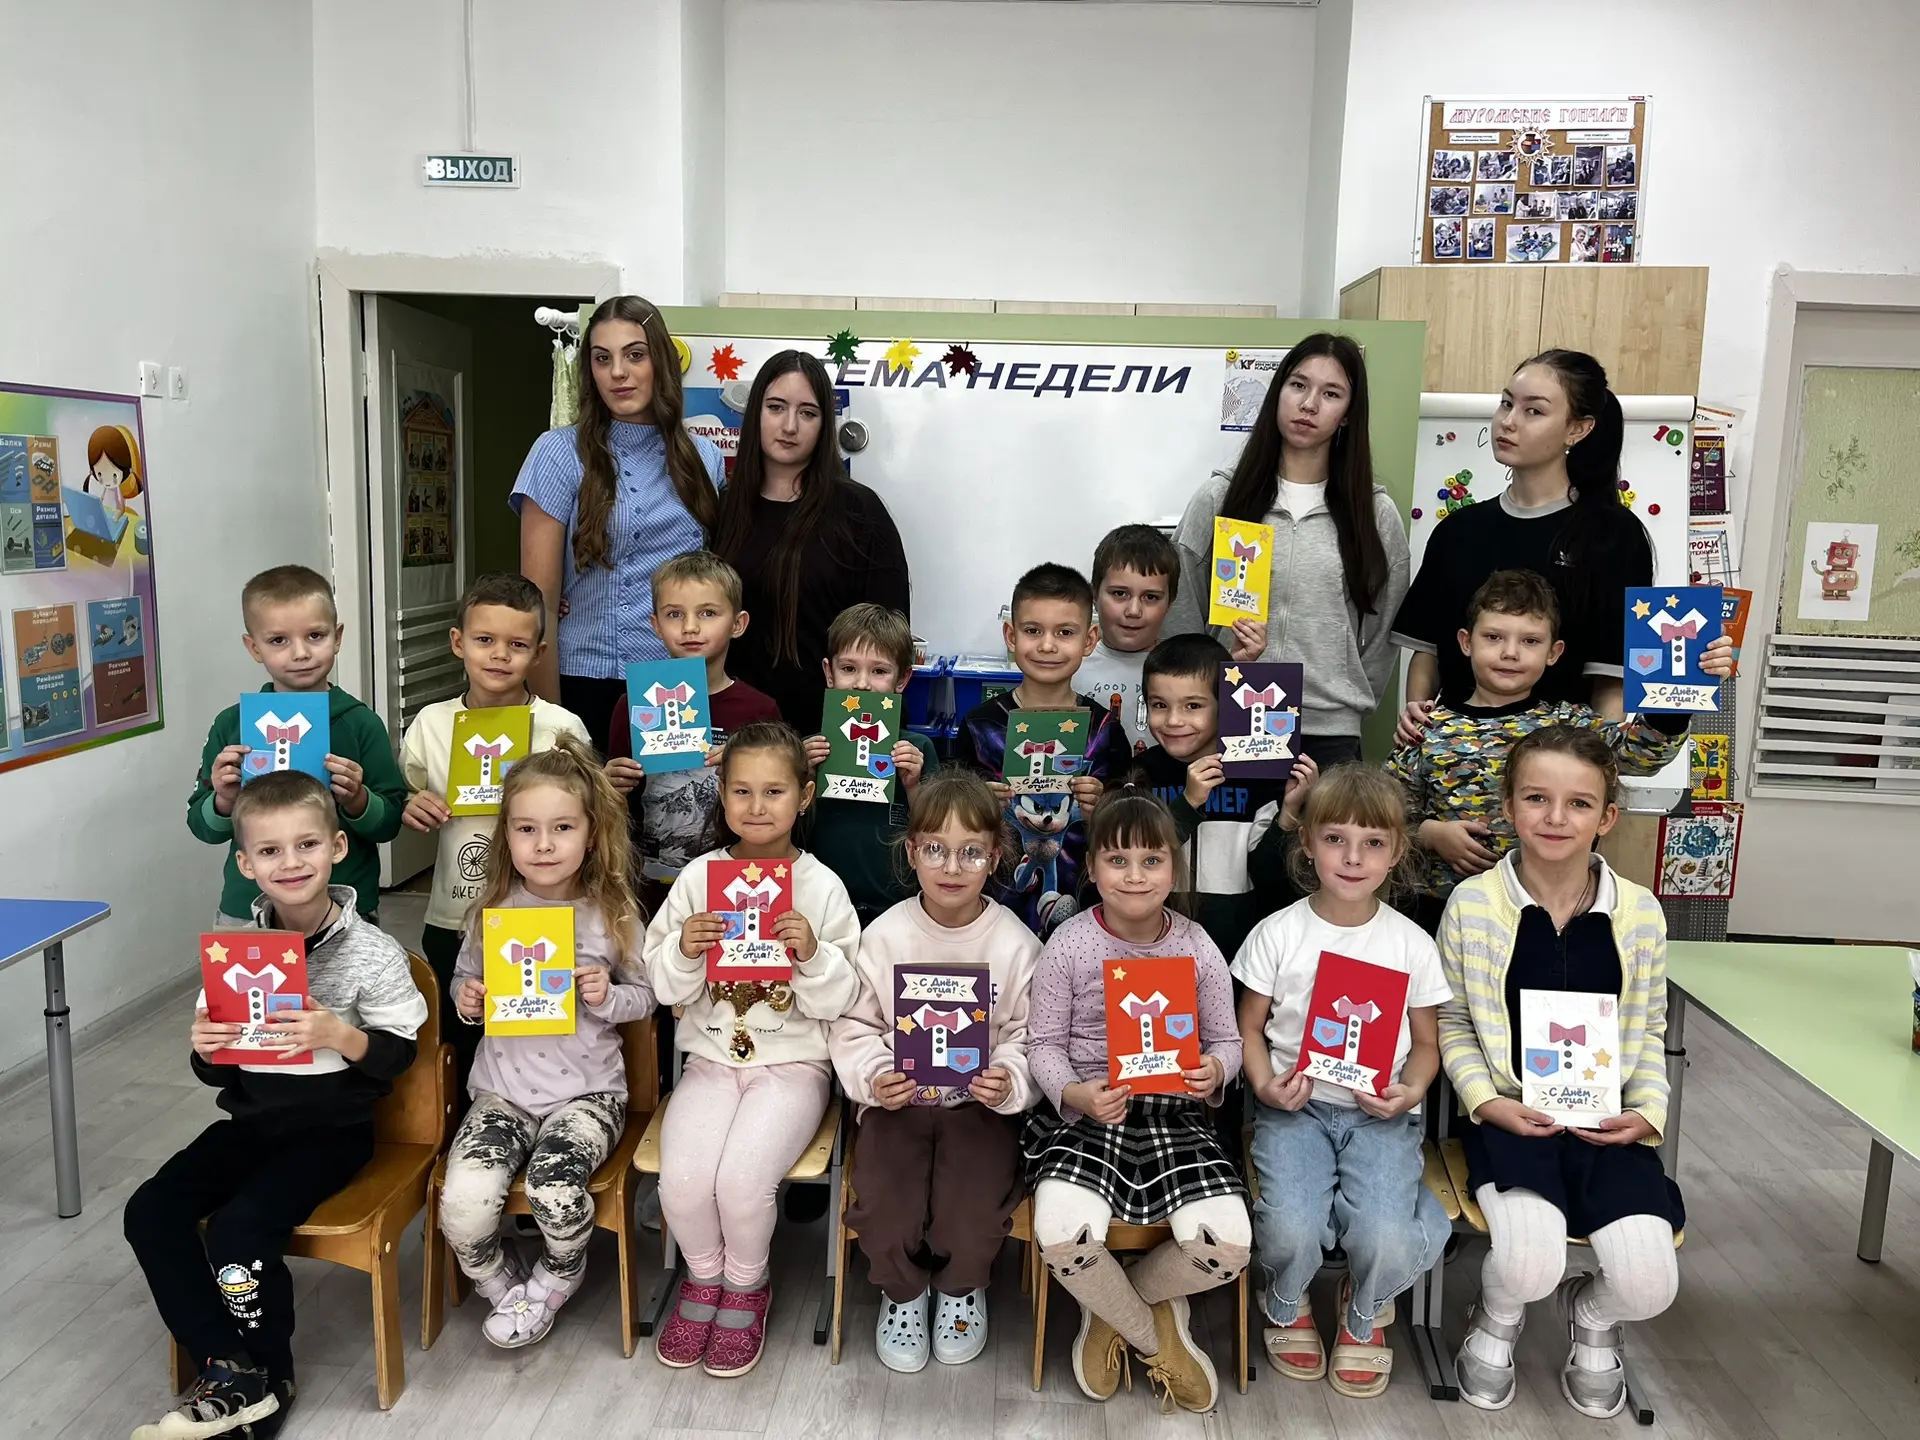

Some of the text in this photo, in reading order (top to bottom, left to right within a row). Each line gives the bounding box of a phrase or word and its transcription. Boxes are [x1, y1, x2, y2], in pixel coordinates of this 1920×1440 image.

[1449, 108, 1551, 123] МУРОМСКИЕ
[429, 159, 509, 181] ВЫХОД
[966, 362, 1191, 398] НЕДЕЛИ
[1234, 590, 1252, 600] Днём
[1230, 597, 1250, 605] отца!
[1094, 682, 1127, 692] GOOD
[1658, 686, 1700, 696] С Днём
[1666, 695, 1696, 703] отца!
[656, 732, 692, 742] С Днём
[663, 738, 689, 748] отца!
[1238, 738, 1275, 748] С Днём
[1245, 746, 1272, 754] отца!
[840, 779, 873, 788] С Днём
[474, 792, 498, 800] отца!
[736, 942, 774, 952] С Днём
[742, 951, 770, 959] отца!
[920, 978, 958, 988] С Днём
[926, 986, 956, 994] отца!
[509, 998, 548, 1008] С Днём
[516, 1006, 546, 1014] отца!
[1132, 1054, 1166, 1065] С Днём
[1138, 1062, 1164, 1070] отца!
[1322, 1058, 1362, 1076] С Днём
[1328, 1070, 1358, 1082] отца!
[1550, 1086, 1591, 1097] С Днём
[1557, 1096, 1588, 1104] отца!
